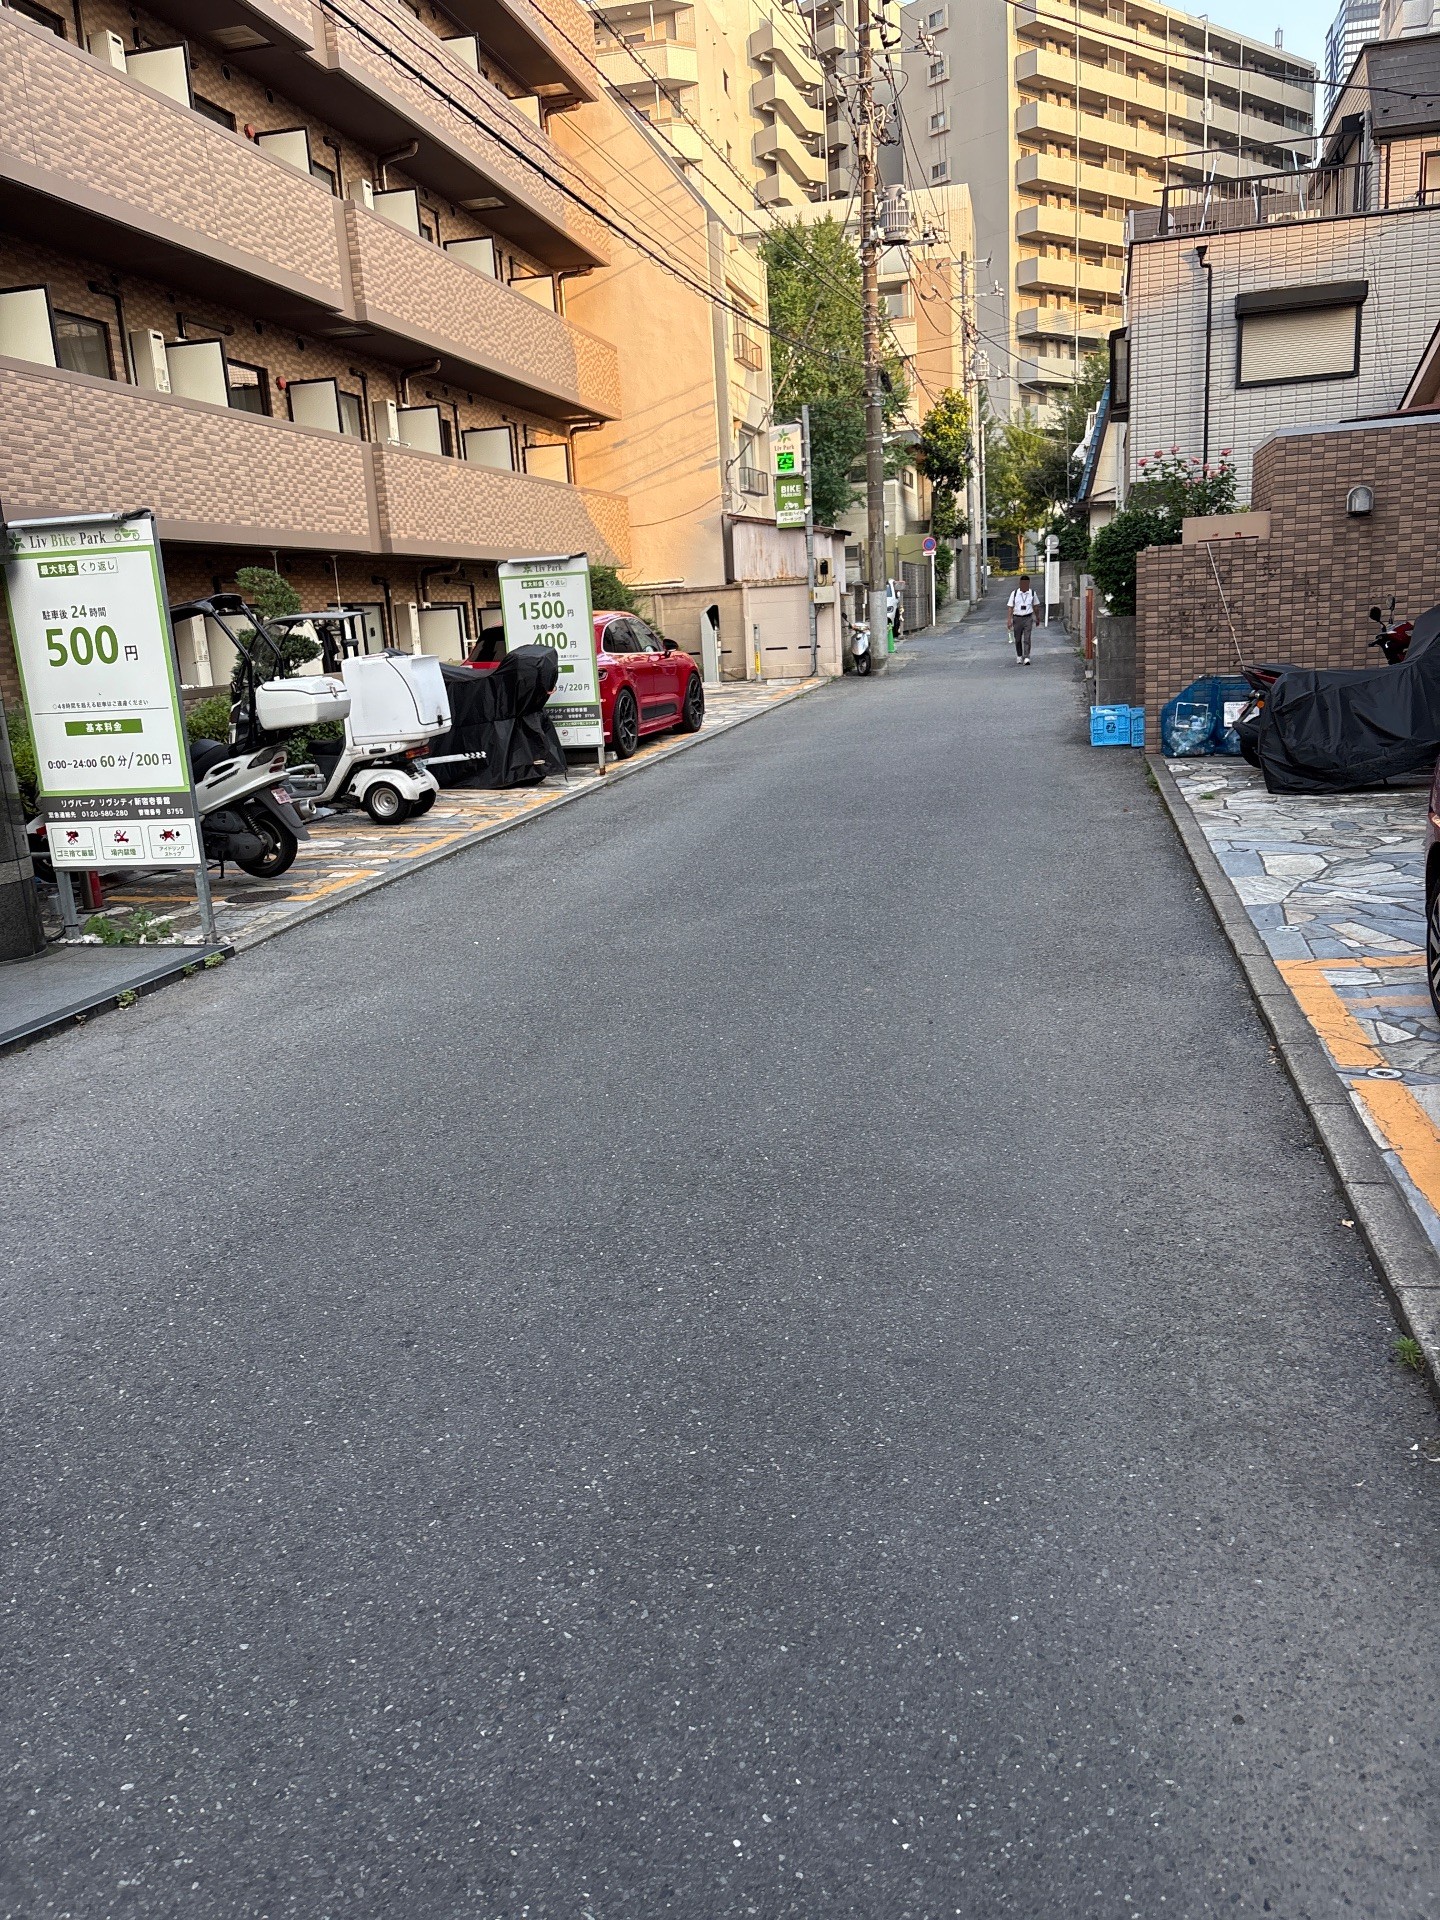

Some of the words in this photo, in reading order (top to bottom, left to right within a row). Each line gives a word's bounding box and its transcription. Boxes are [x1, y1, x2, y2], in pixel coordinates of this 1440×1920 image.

[777, 452, 794, 471] 空
[781, 485, 801, 493] BIKE
[29, 535, 47, 548] Liv
[51, 532, 76, 547] Bike
[79, 531, 107, 545] Park
[40, 562, 77, 576] 最大料金
[80, 560, 115, 573] くり返し
[547, 564, 563, 572] Park
[86, 722, 123, 733] 基本料金
